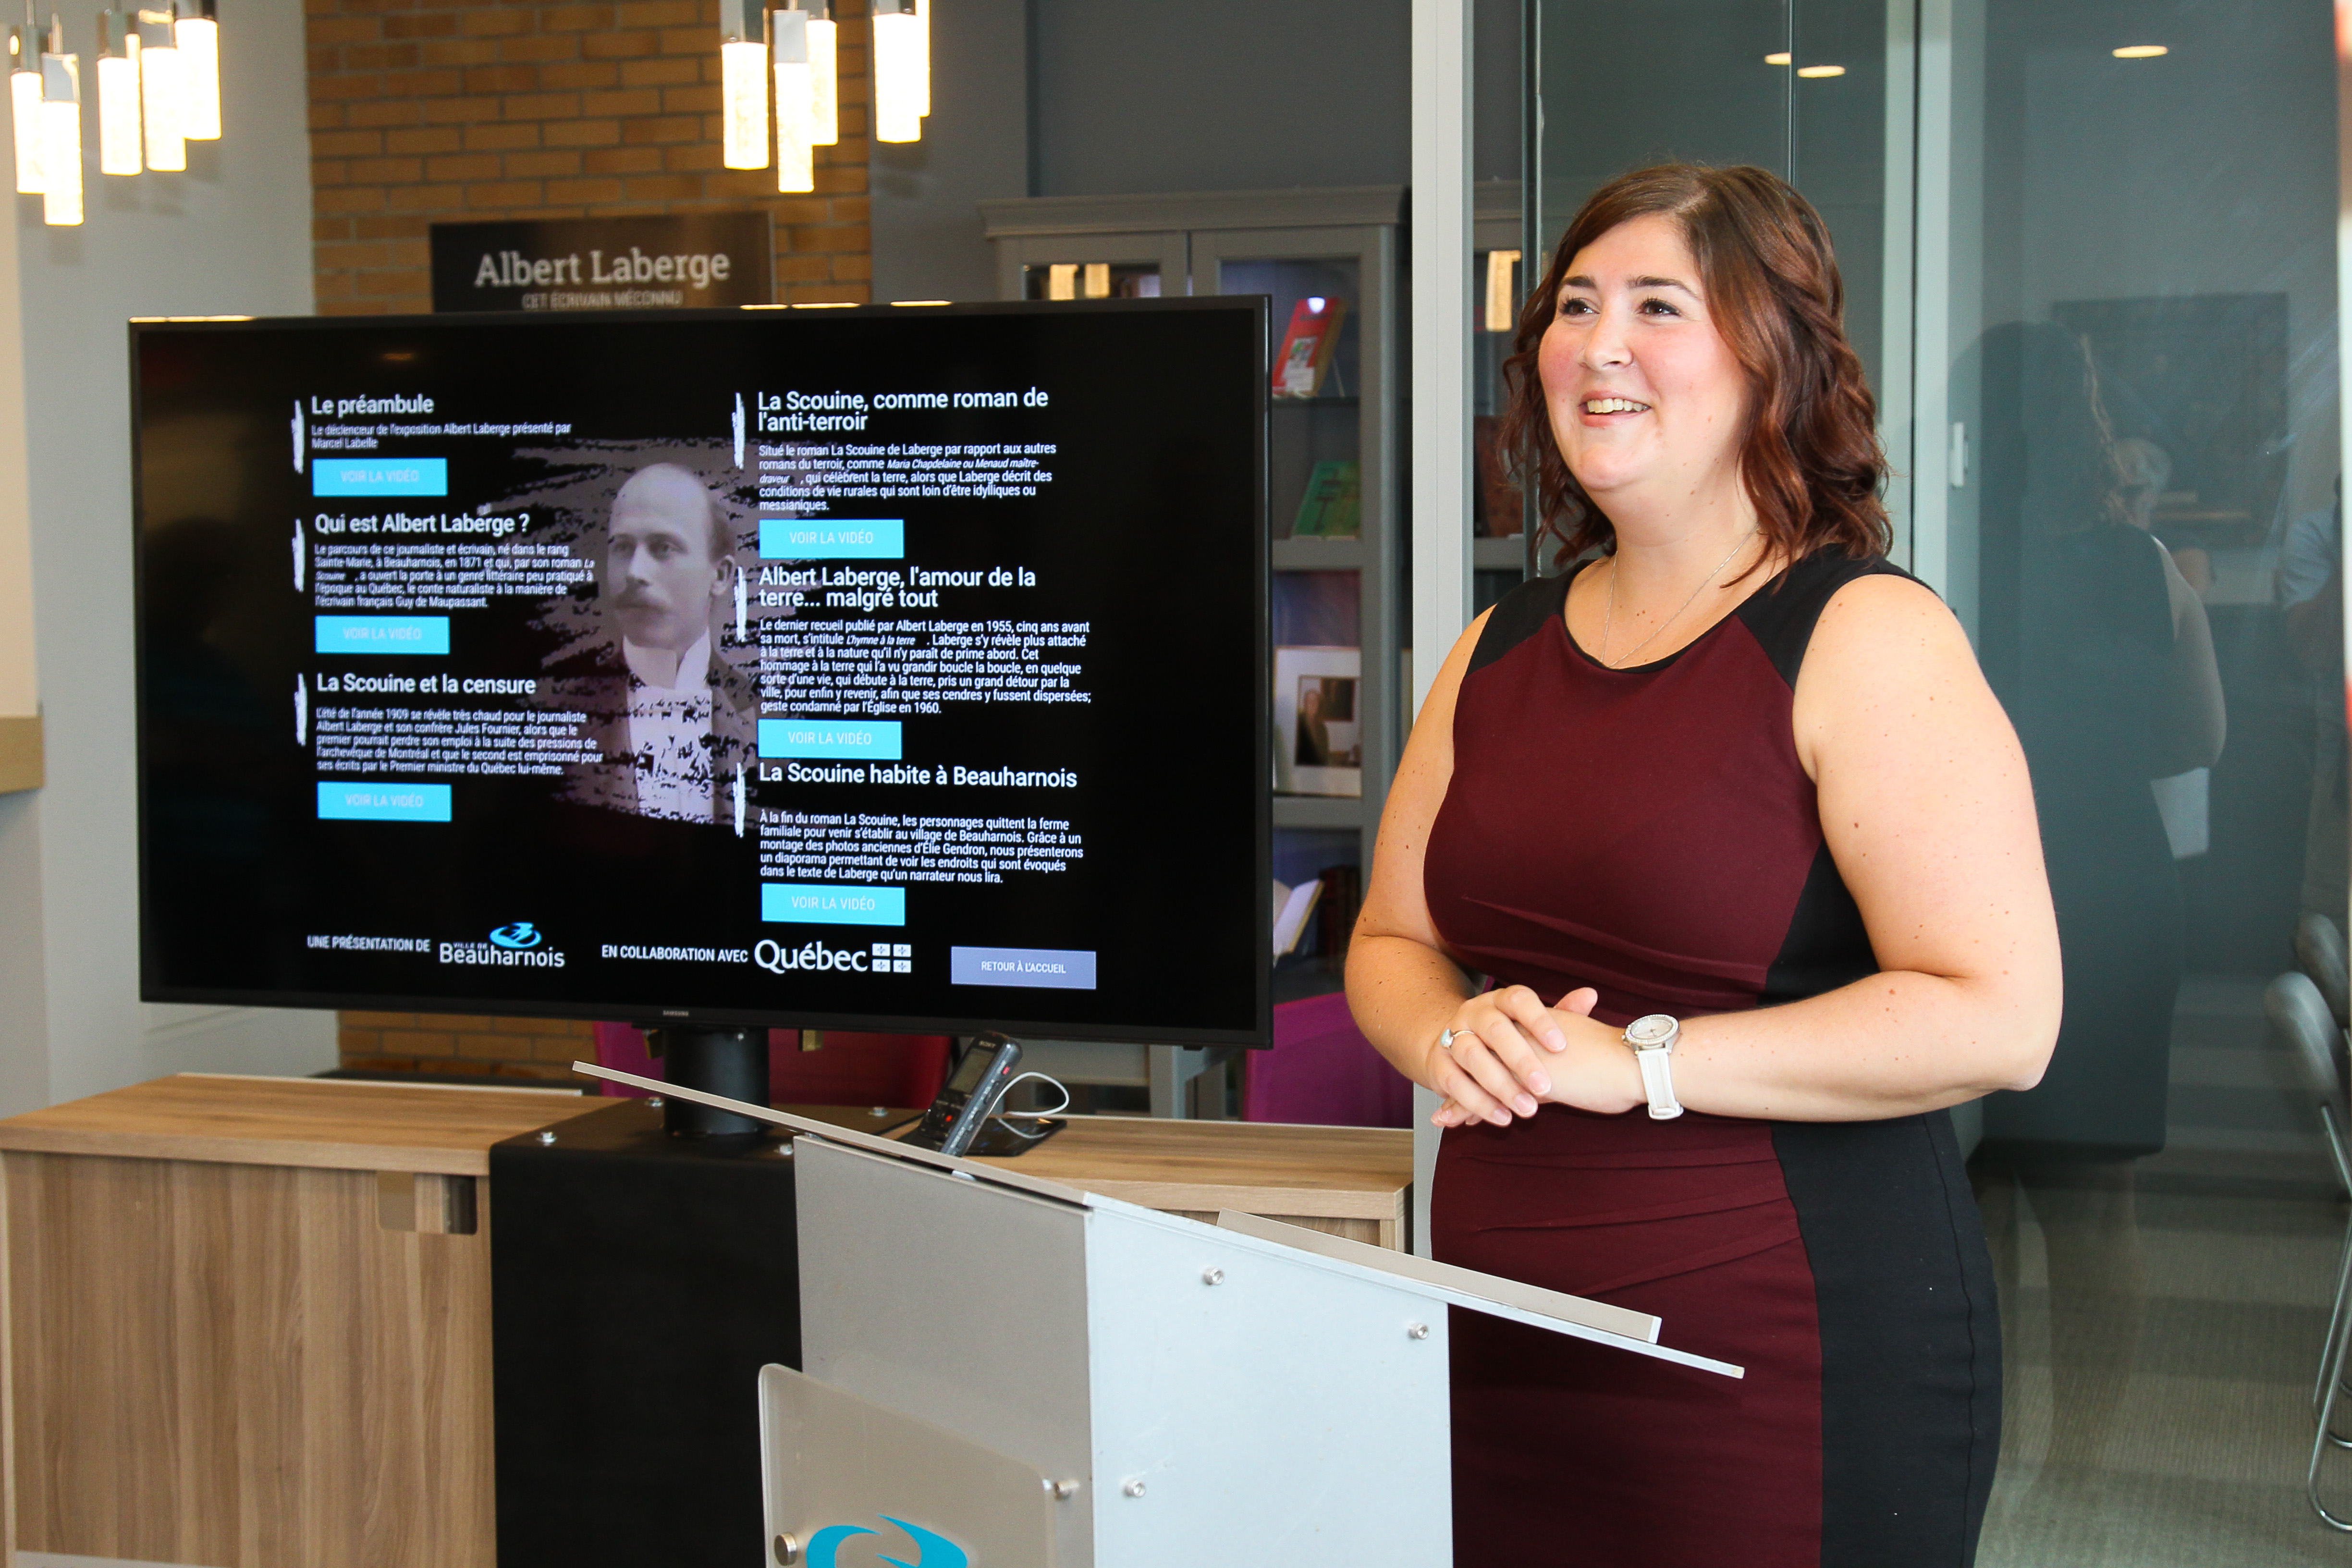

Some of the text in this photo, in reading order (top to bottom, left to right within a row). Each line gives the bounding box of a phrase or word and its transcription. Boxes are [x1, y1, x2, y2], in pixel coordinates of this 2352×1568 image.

[475, 247, 731, 289] Albert Laberge
[312, 393, 434, 419] Le préambule
[759, 387, 1048, 413] La Scouine, comme roman de
[759, 411, 868, 431] l'anti-terroir
[759, 444, 1056, 457] Situé le roman La Scouine de Laberge par rapport aux autres
[759, 462, 797, 470] romans
[797, 459, 812, 469] du
[812, 459, 844, 471] terroir,
[846, 461, 884, 469] comme
[887, 458, 910, 469] Maria
[912, 457, 961, 471] Chapdelaine
[975, 457, 1008, 468] Menaud
[1009, 457, 1039, 468] maître-
[341, 468, 418, 482] VOIR LA VIDÉO
[806, 471, 1052, 486] qui célèbrent la terre, alors que Laberge décrit des
[760, 485, 1036, 499] conditions de vie rurales qui sont loin d'être idylliques ou
[760, 500, 829, 513] messianiques.
[315, 514, 529, 537] Qui est Albert Laberge ?
[790, 529, 873, 543] VOIR LA VIDÉO
[759, 567, 1035, 590] Albert Laberge, l'amour de la
[760, 588, 938, 611] terre... malgré tout
[343, 626, 421, 640] VOIR LA VIDÉO
[760, 619, 1089, 635] Le dernier recueil publié par Albert Laberge en 1955, cinq ans avant
[318, 674, 536, 694] La Scouine et la censure
[760, 699, 941, 715] geste condamné par l'Église en 1960.
[788, 729, 871, 744] VOIR LA VIDÉO
[760, 764, 1077, 786] La Scouine habite à Beauharnois
[346, 793, 423, 807] VOIR LA VIDÉO
[760, 810, 1069, 832] À la fin du roman La Scouine, les personnages quittent la ferme
[792, 895, 875, 910] VOIR LA VIDÉO
[307, 934, 430, 952] UNE PRÉSENTATION DE
[440, 943, 565, 968] Beauharnois
[601, 945, 748, 963] EN COLLABORATION AVEC
[754, 939, 868, 974] Québec
[981, 960, 1066, 974] RETOUR À L'ACCUEIL
